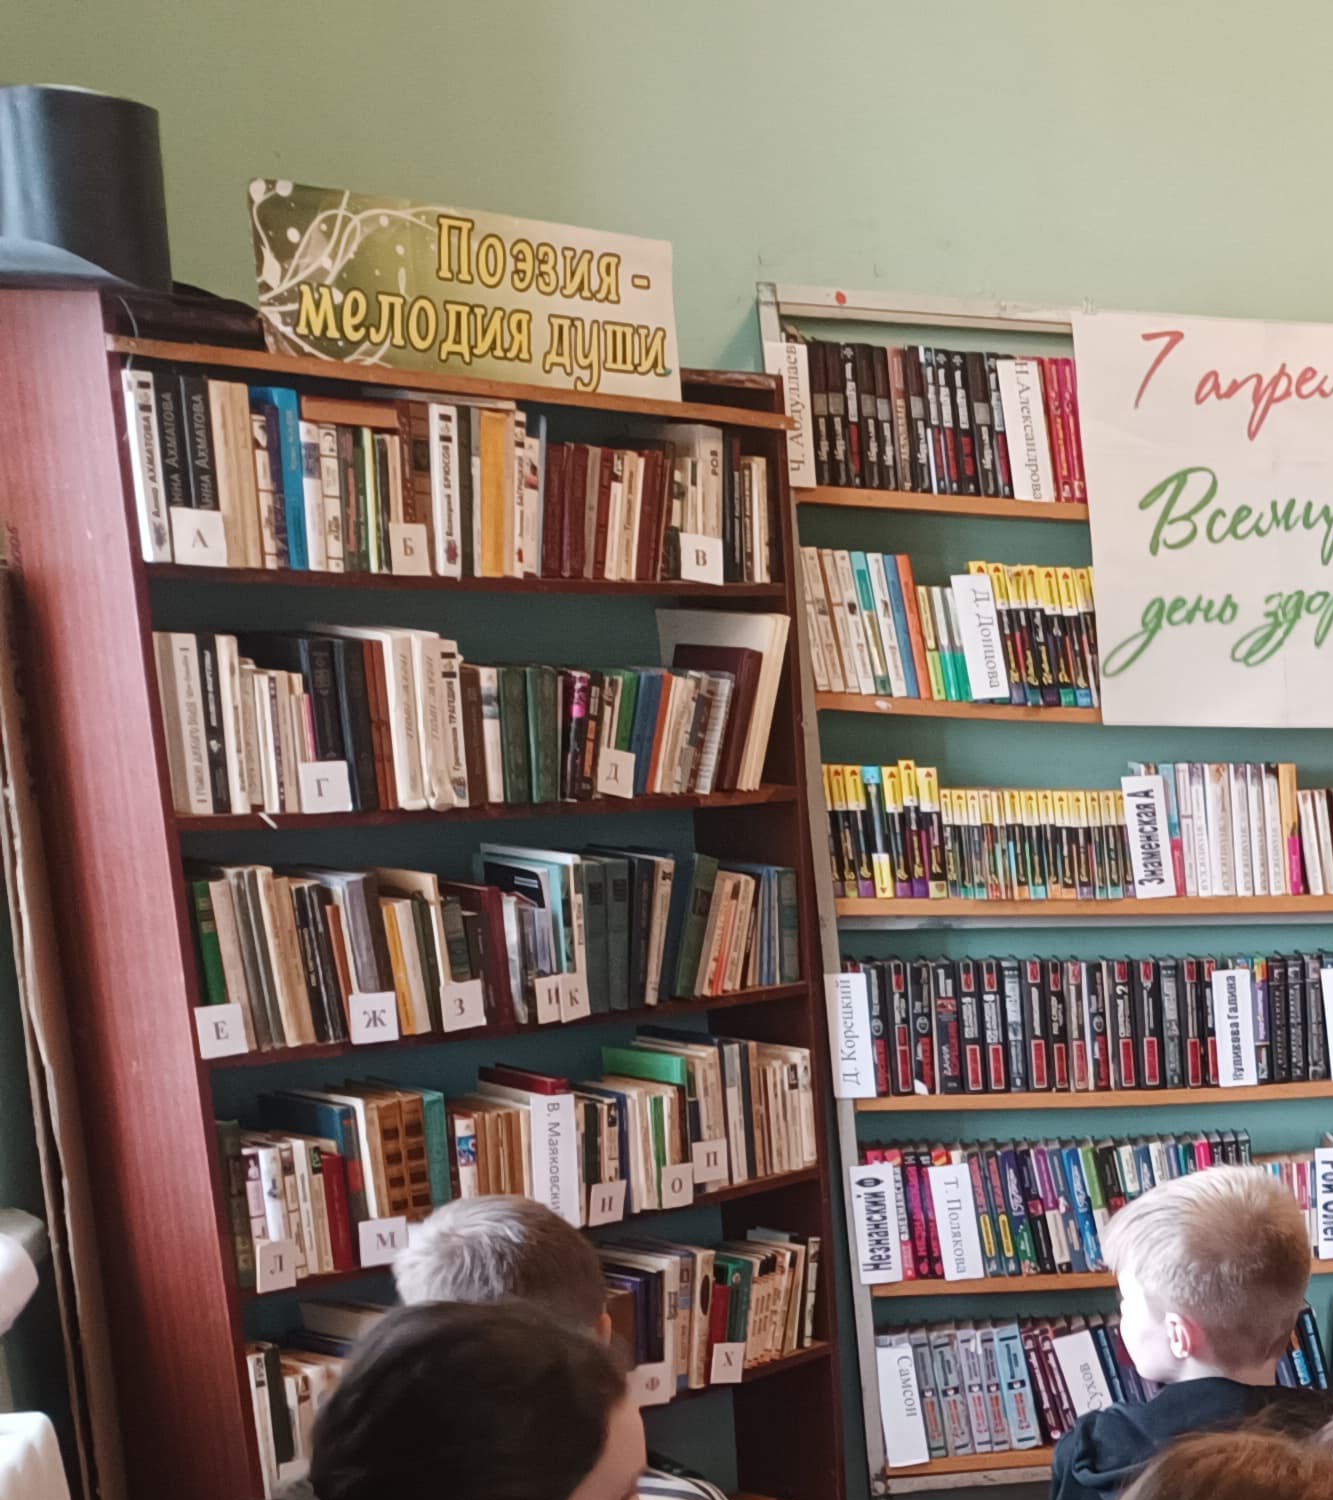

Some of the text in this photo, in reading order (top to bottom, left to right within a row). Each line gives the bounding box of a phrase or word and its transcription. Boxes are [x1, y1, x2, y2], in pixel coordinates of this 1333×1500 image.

[435, 215, 621, 304] Поэзия
[295, 283, 674, 392] мелодия души
[1132, 330, 1184, 409] 7
[784, 343, 806, 444] Абдуллаев
[168, 472, 184, 507] ННА
[402, 536, 415, 557] Б
[695, 549, 707, 568] В
[1102, 589, 1239, 678] день
[975, 613, 1002, 690] Донцова
[315, 777, 328, 798] Г
[605, 763, 620, 782] Д
[1126, 787, 1166, 887] Знаменская А
[362, 1009, 387, 1029] Ж
[453, 998, 466, 1016] З
[835, 978, 860, 1062] Корецкий
[213, 1020, 229, 1040] Е
[1226, 974, 1245, 1082] Куликова Галина
[547, 1120, 565, 1213] Маяковски
[704, 1151, 719, 1168] П
[670, 1178, 683, 1193] О
[376, 1231, 397, 1250] М
[855, 1175, 893, 1273] Незнанский Ф
[943, 1177, 967, 1275] Т. Полякова
[269, 1253, 284, 1275] Л
[722, 1352, 735, 1368] Х
